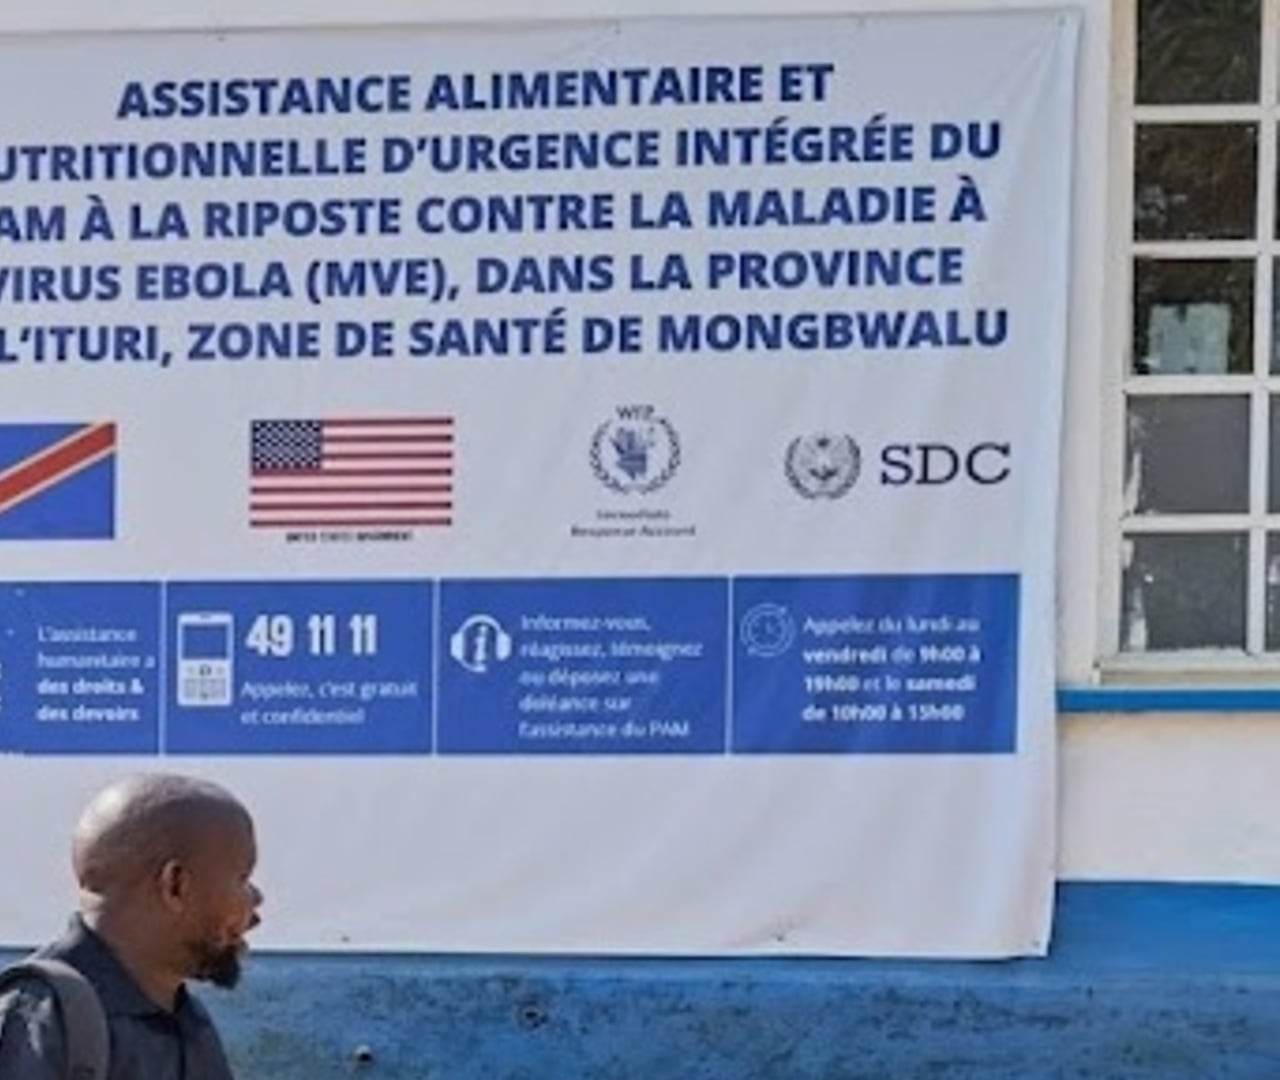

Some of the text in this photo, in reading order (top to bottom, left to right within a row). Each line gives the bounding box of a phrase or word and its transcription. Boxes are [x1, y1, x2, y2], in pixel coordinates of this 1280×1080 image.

[116, 63, 834, 118] ASSISTANCE ALIMENTAIRE ET
[382, 131, 659, 174] D'URGENCE
[675, 113, 914, 167] INTÉGRÉE
[930, 122, 1001, 160] DU
[80, 194, 114, 241] À
[129, 202, 189, 240] LA
[204, 199, 401, 238] RIPOSTE
[416, 194, 614, 234] CONTRE
[630, 191, 692, 230] LA
[708, 186, 936, 227] MALADIE
[949, 174, 987, 222] À
[136, 261, 293, 301] EBOLA
[306, 257, 459, 304] (MVE),
[477, 255, 614, 293] DANS
[630, 254, 692, 291] LA
[708, 247, 963, 290] PROVINCE
[187, 323, 321, 361] ZONE
[336, 321, 394, 357] DE
[408, 307, 566, 356] SANTÉ
[582, 316, 643, 353] DE
[659, 310, 1007, 352] MONGBWALU
[880, 443, 1011, 485] SDC
[38, 625, 137, 642] L'assistance
[245, 613, 378, 656] 49 11 11
[803, 617, 876, 636] Appelez
[878, 617, 902, 633] du
[906, 615, 954, 633] lundi
[38, 652, 140, 668] humanitaire
[803, 646, 887, 664] vendredi
[890, 647, 916, 663] de
[919, 646, 966, 663] 9h00
[37, 678, 144, 695] des droits &
[319, 682, 355, 698] c'est
[360, 682, 417, 702] gratuit
[863, 674, 881, 691] et
[884, 673, 902, 691] le
[906, 674, 976, 692] samedi
[37, 704, 139, 721] des devoirs
[603, 697, 632, 711] sur
[803, 704, 827, 722] de
[241, 707, 366, 725] et confidentiel
[620, 719, 646, 737] du
[650, 721, 689, 737] PAM
